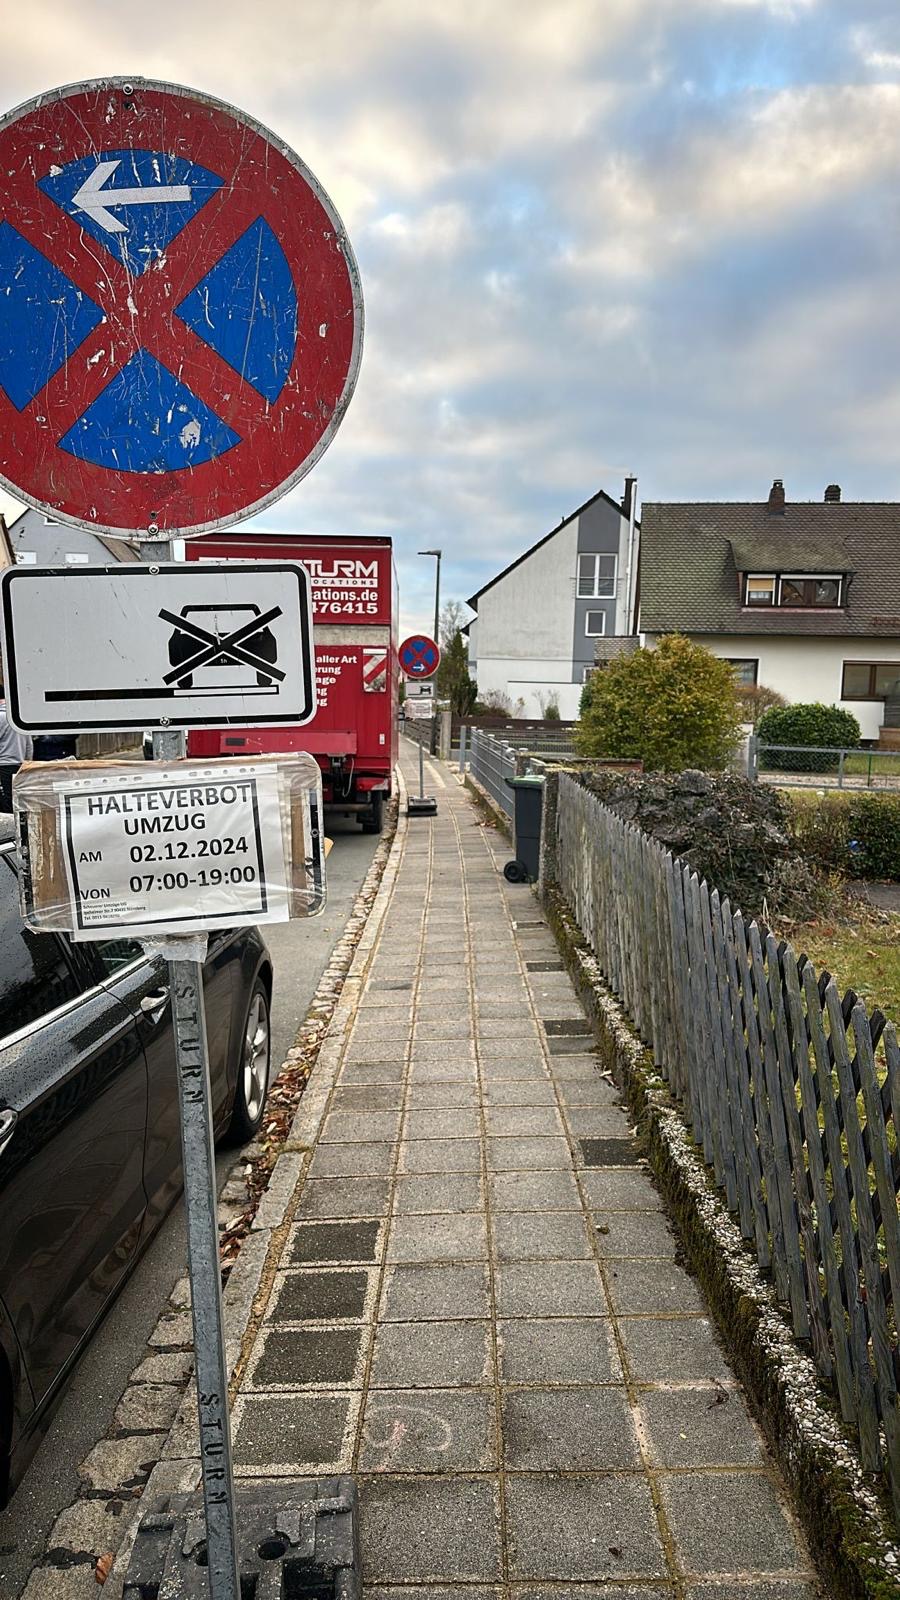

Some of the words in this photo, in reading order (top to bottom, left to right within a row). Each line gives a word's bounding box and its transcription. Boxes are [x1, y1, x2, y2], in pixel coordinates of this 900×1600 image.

[301, 559, 378, 578] TURM
[312, 588, 378, 601] ations.de
[316, 655, 340, 664] aller
[341, 655, 358, 664] Art
[315, 666, 342, 675] rung
[88, 784, 251, 816] HALTEVERBOT
[124, 813, 206, 836] UMZUG
[79, 851, 102, 863] AM
[130, 837, 249, 863] 02.12.2024
[80, 887, 110, 901] VON
[130, 866, 256, 893] 07:00-19:00
